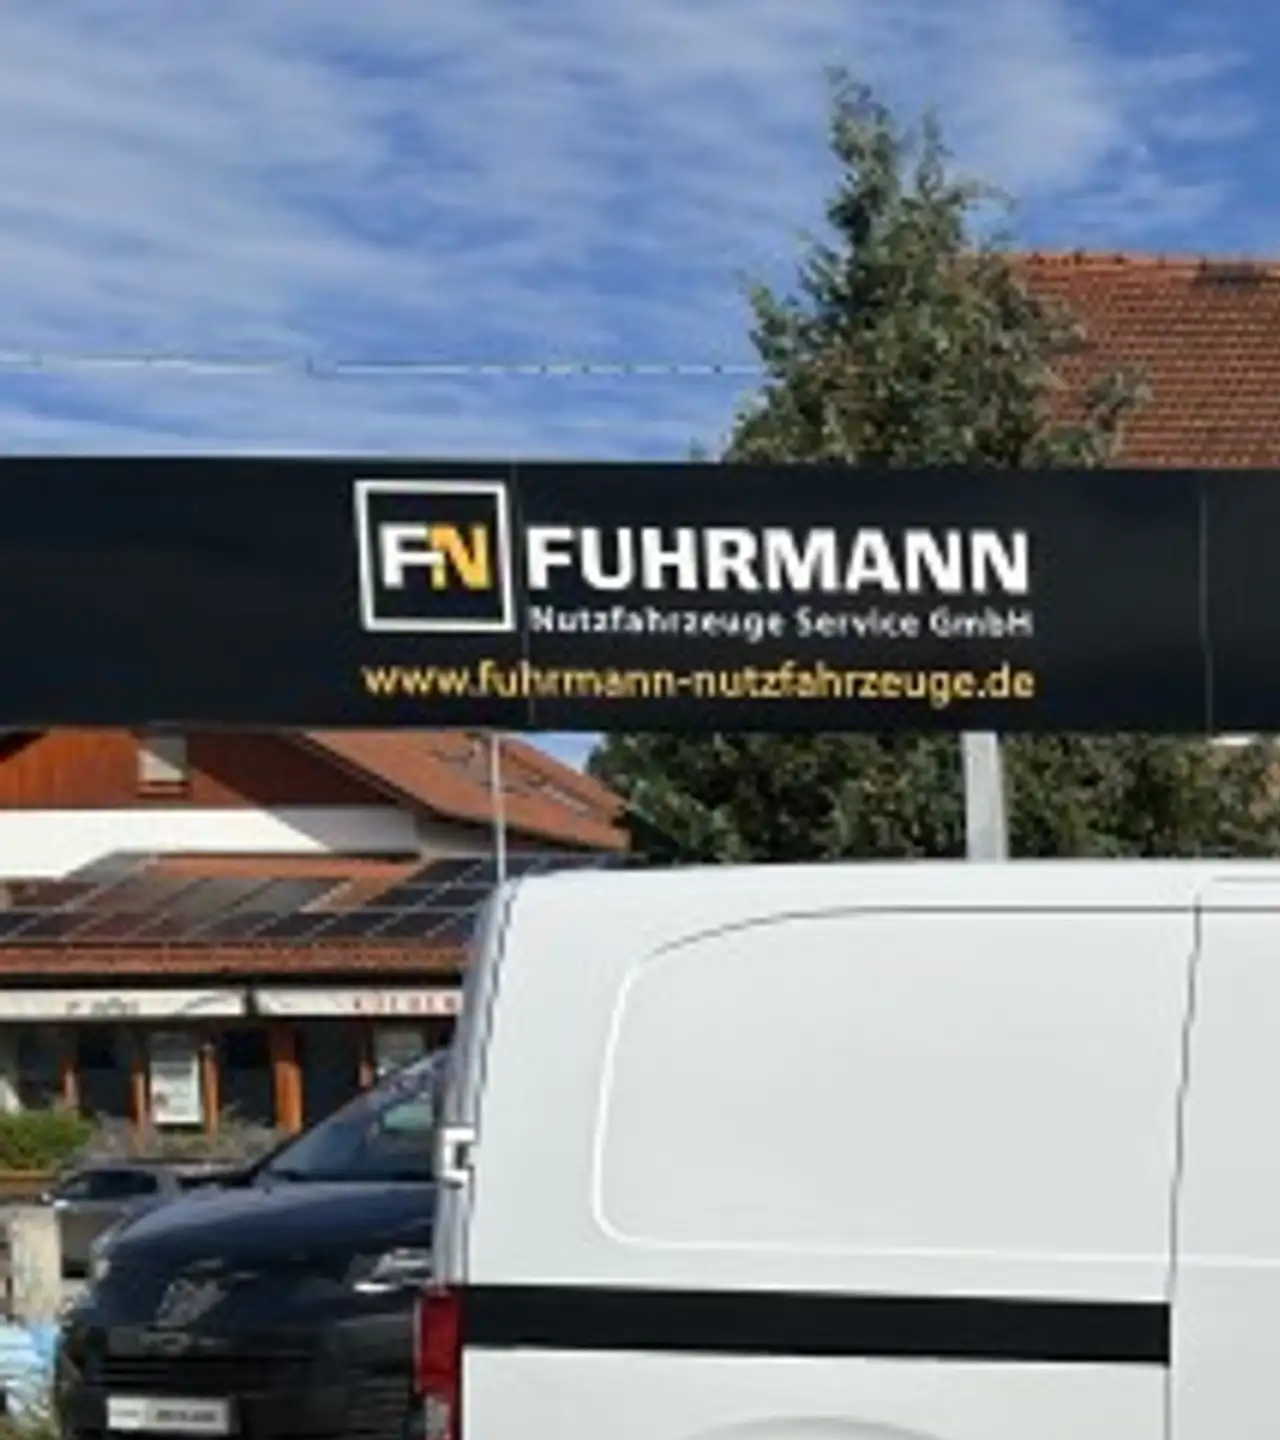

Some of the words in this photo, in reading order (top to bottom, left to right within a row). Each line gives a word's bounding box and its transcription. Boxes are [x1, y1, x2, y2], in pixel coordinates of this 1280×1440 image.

[378, 523, 492, 590] FN
[527, 526, 1030, 594] FUHRMANN
[530, 603, 785, 639] Nutzfahrzeuge
[797, 607, 918, 637] Service
[929, 609, 1033, 638] GmbH
[361, 659, 1035, 707] www.fuhrmann-nutzfahrzeuge.de
